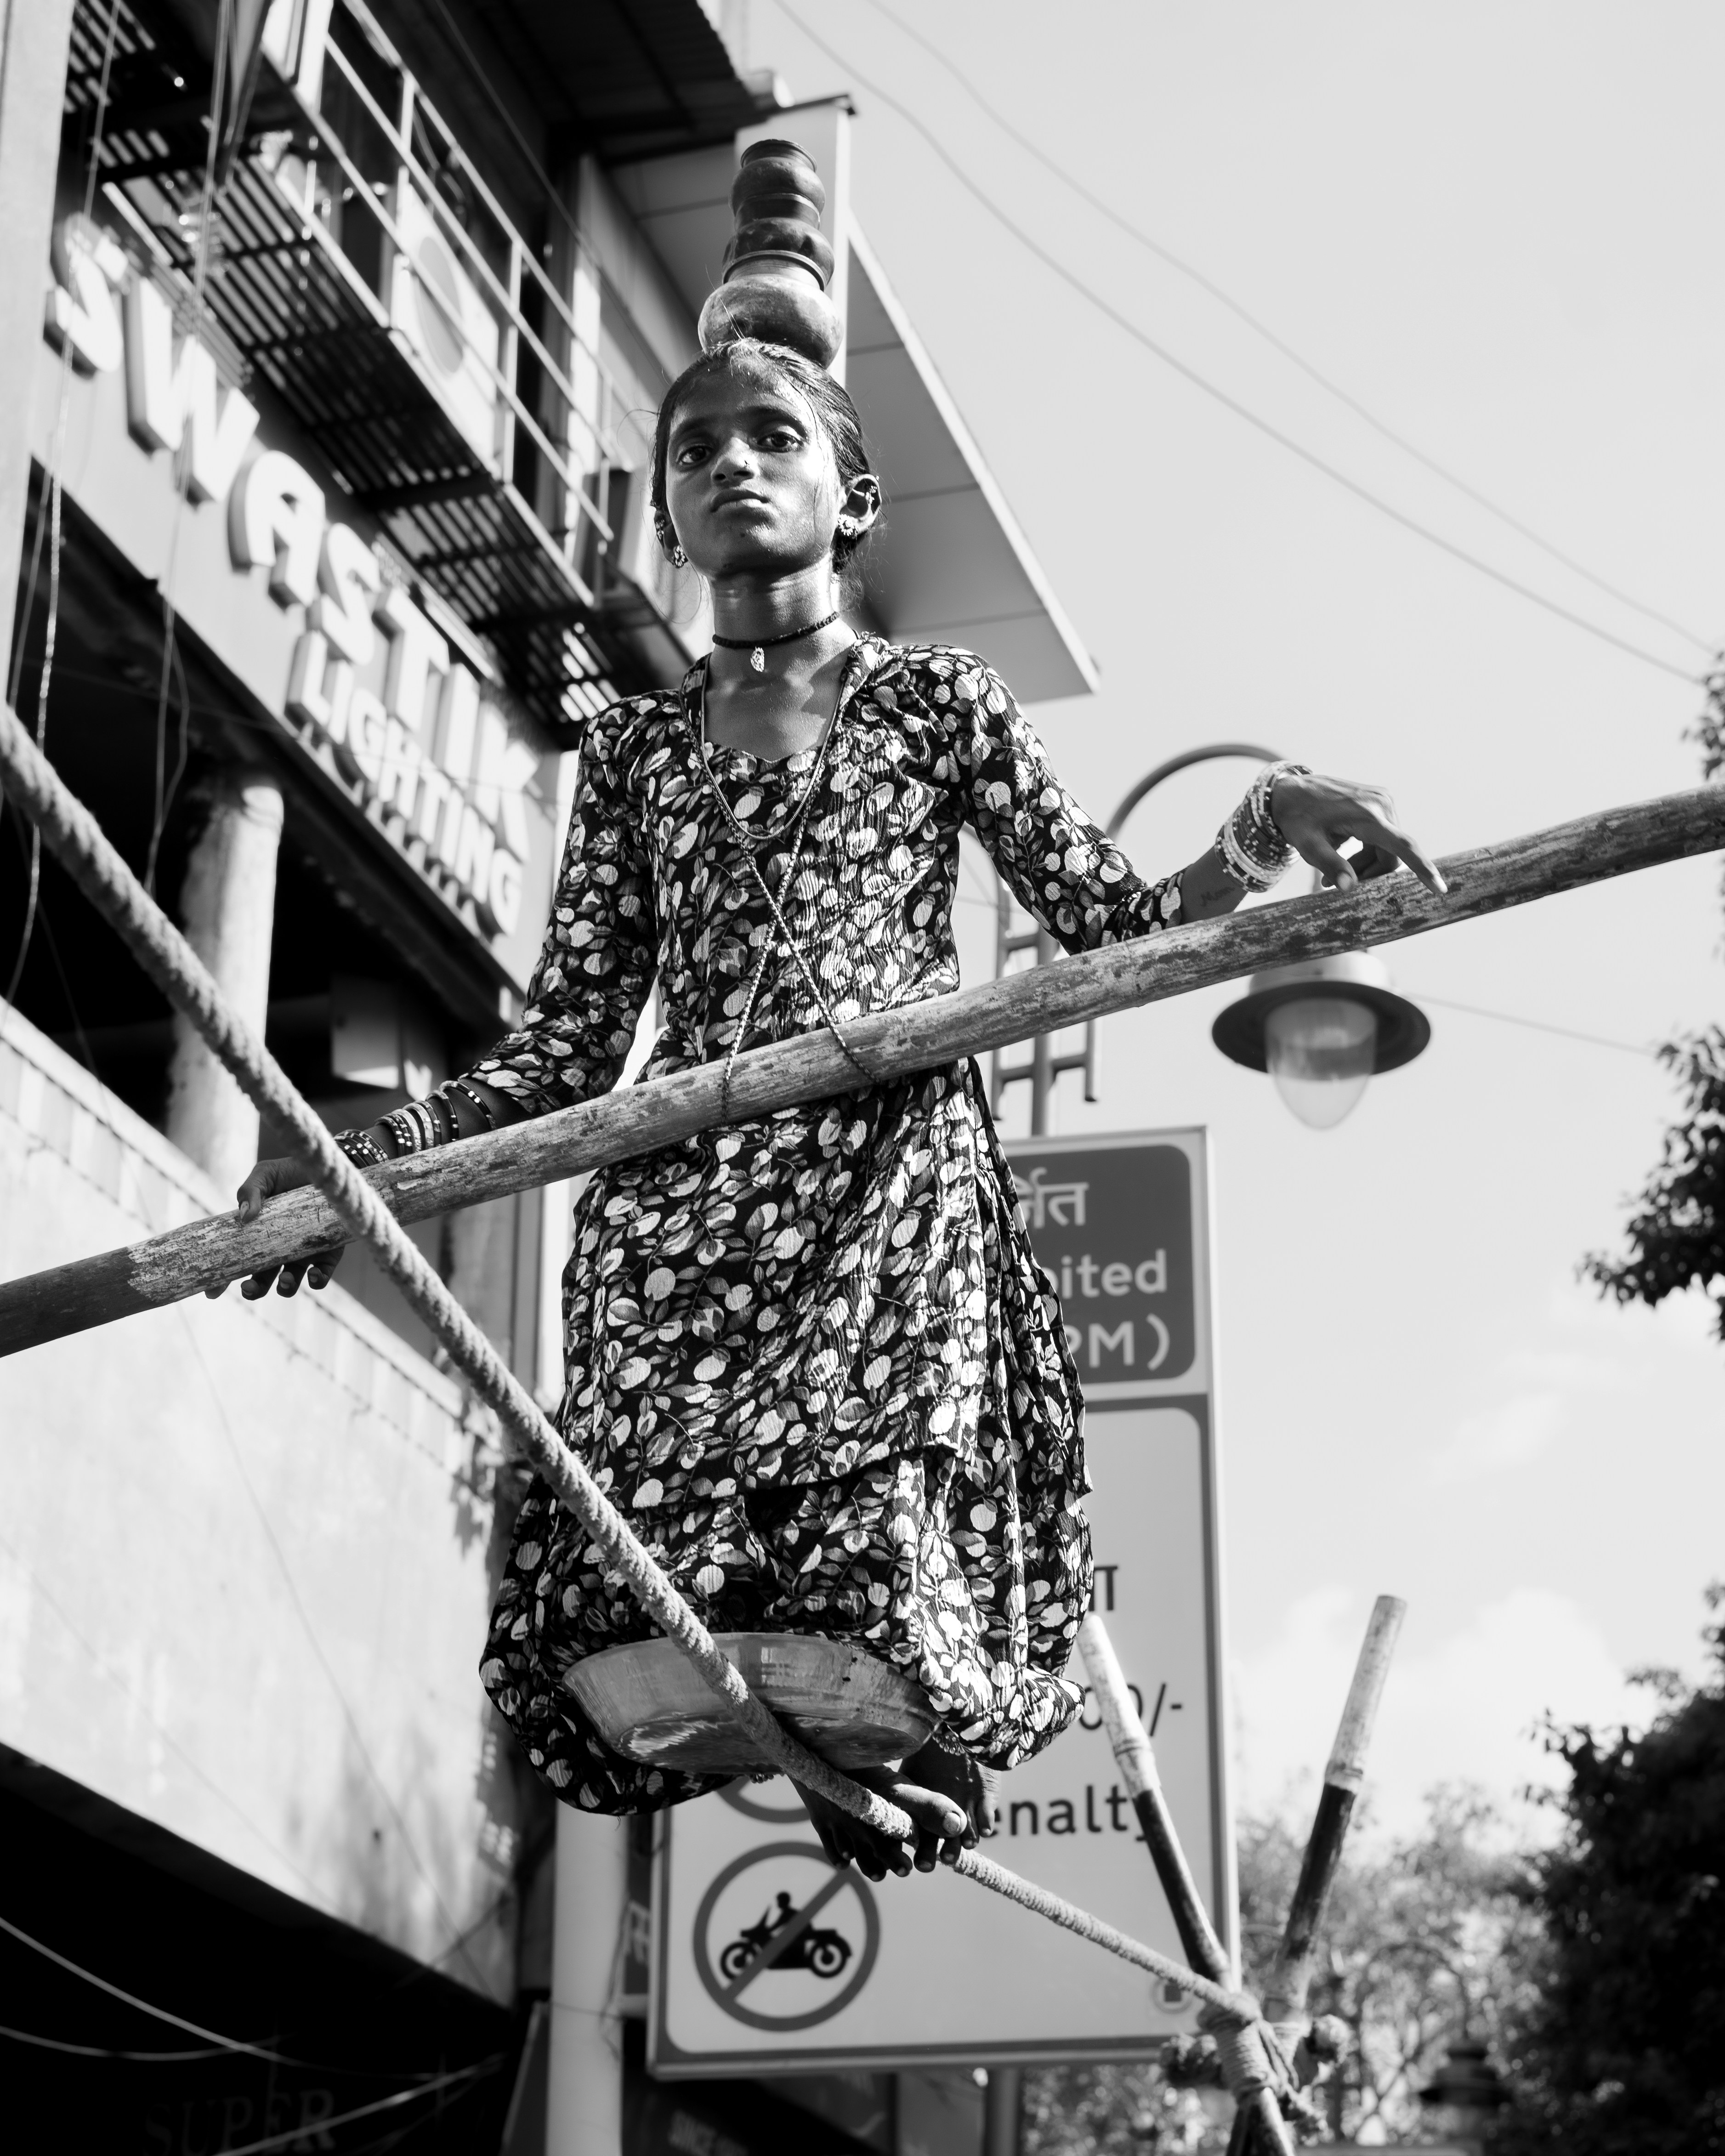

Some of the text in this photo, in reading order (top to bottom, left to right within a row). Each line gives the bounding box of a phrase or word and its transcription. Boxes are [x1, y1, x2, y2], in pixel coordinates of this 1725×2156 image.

[45, 212, 540, 866] SWASTIK
[286, 630, 523, 937] LIGHTING
[989, 1784, 1147, 1842] nalt
[142, 2087, 337, 2156] SUPER
